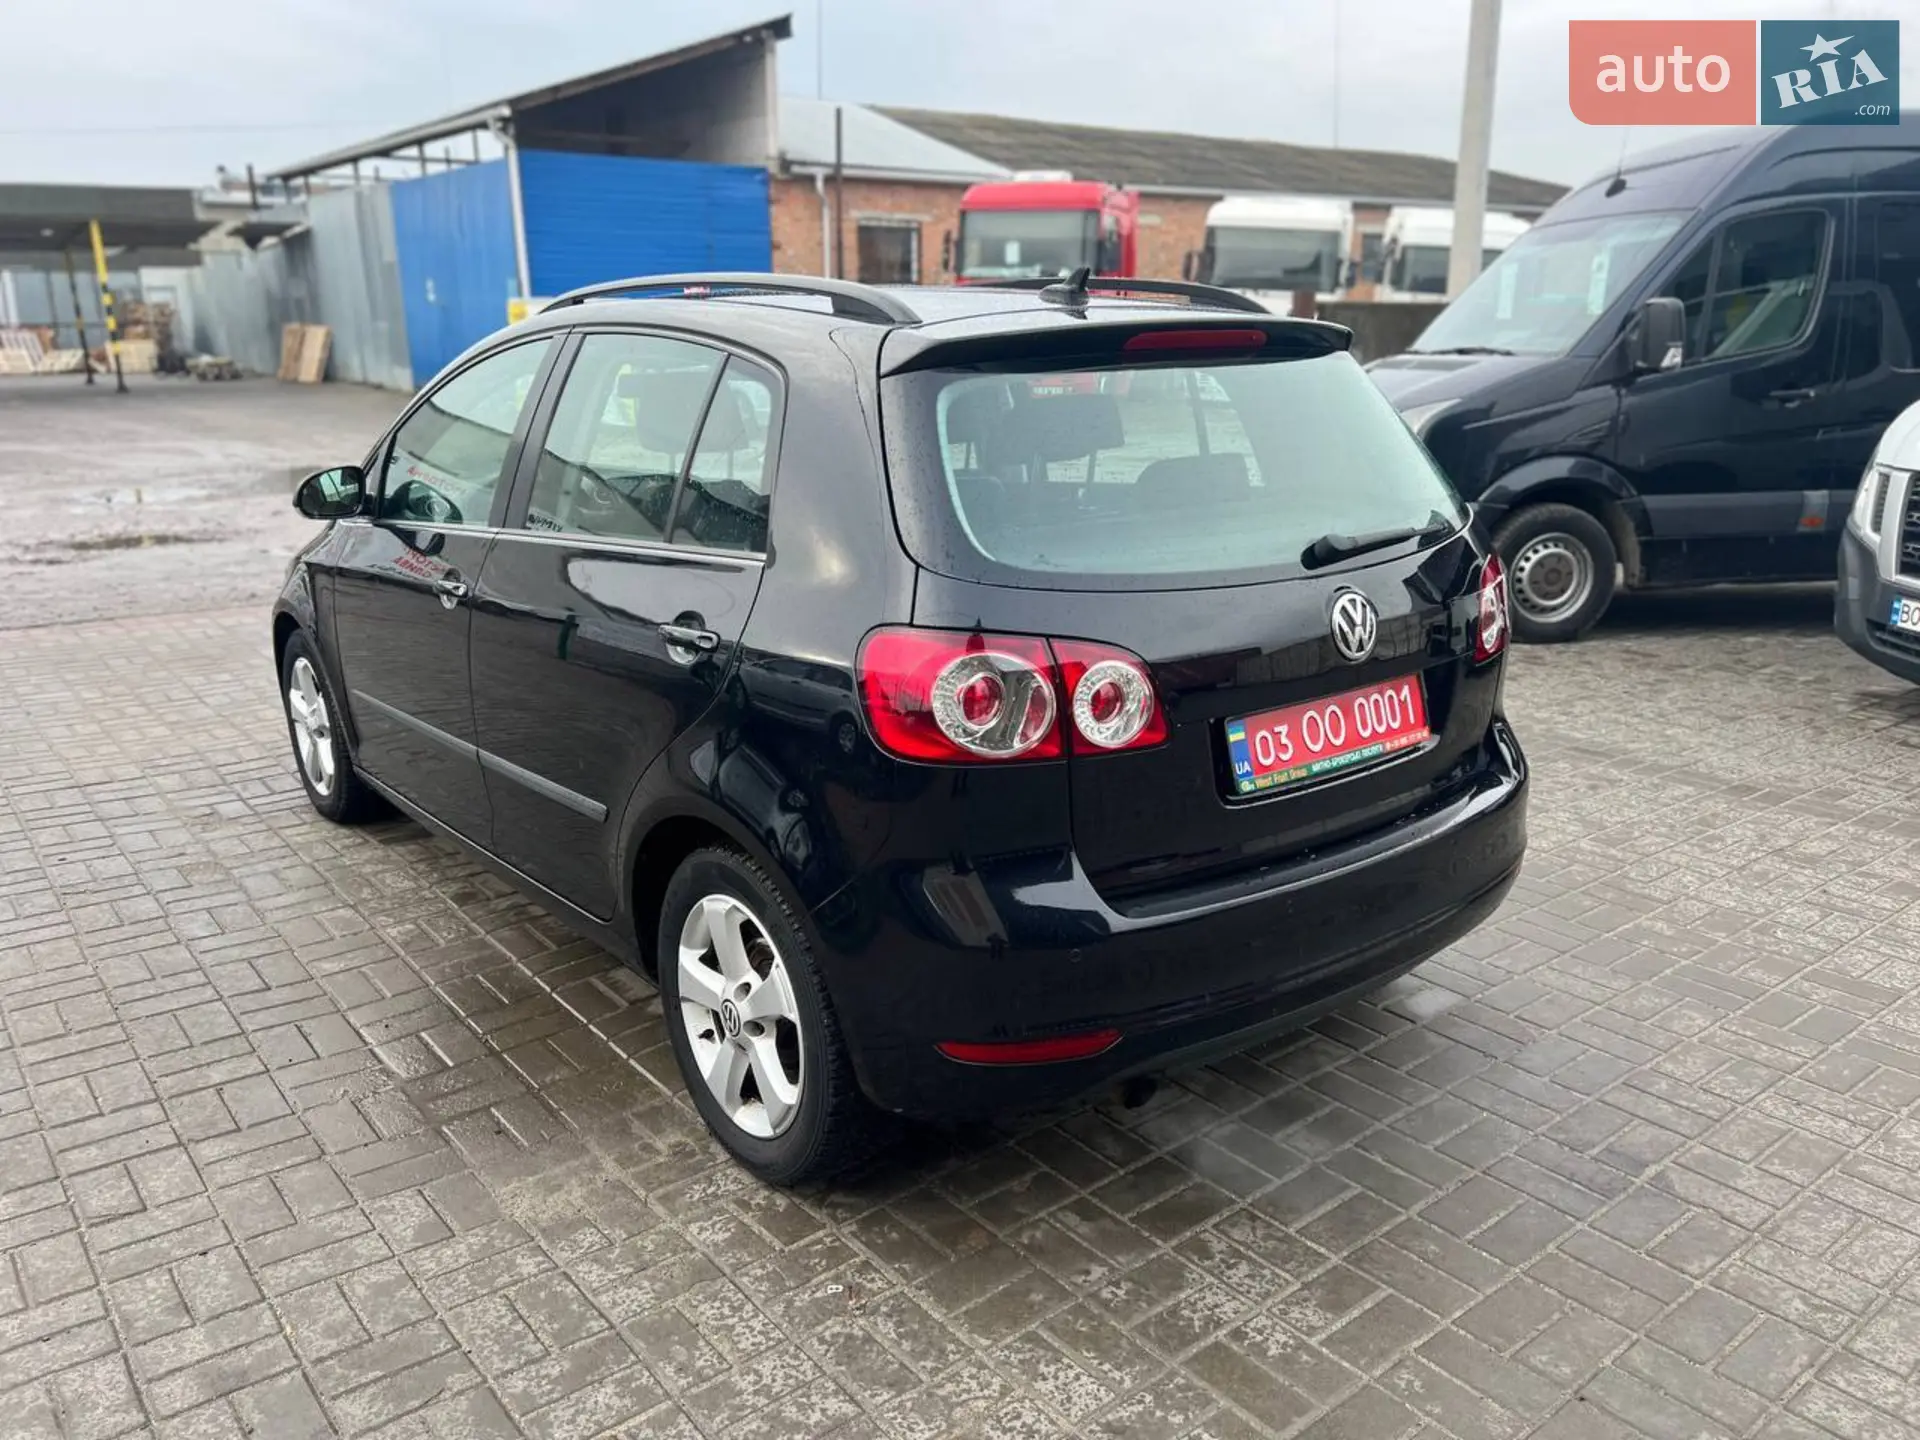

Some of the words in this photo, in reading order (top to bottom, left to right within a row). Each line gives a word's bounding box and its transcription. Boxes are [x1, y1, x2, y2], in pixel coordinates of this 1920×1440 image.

[1254, 723, 1294, 767] 03
[1353, 684, 1415, 739] 0001
[1235, 760, 1252, 775] UA
